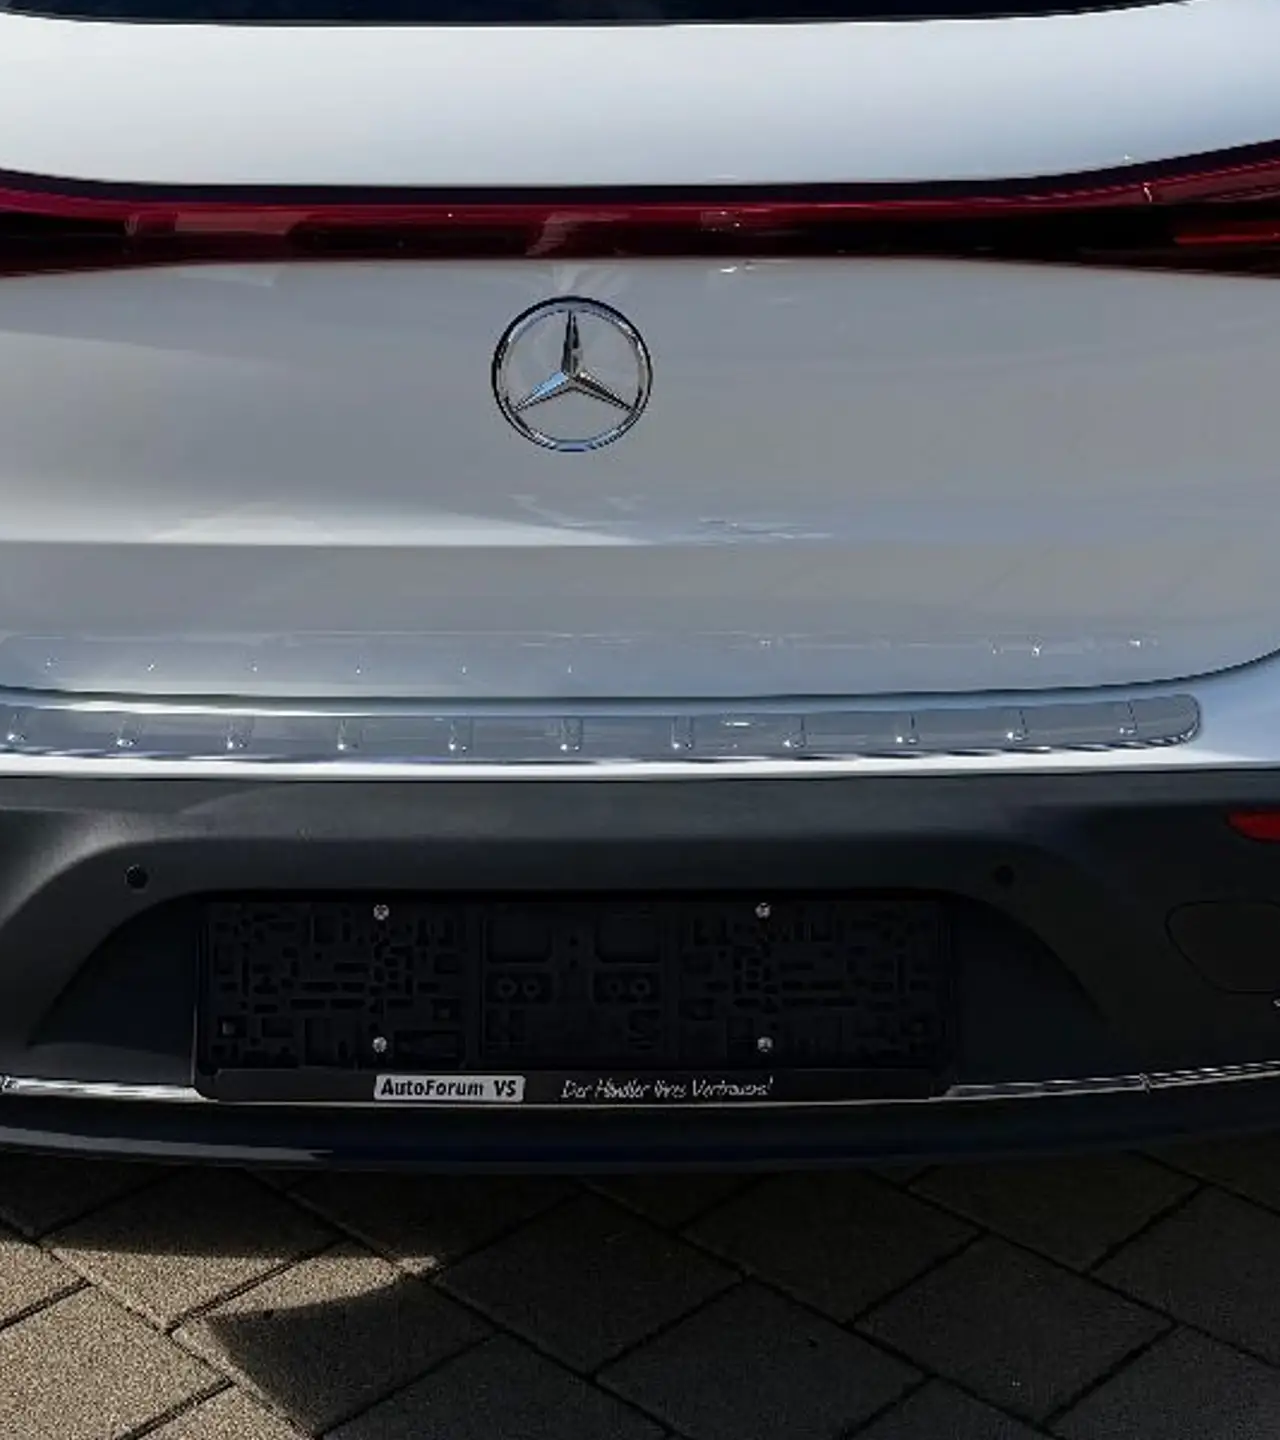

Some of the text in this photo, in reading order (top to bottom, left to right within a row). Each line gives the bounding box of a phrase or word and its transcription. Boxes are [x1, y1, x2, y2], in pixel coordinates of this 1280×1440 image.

[381, 1078, 484, 1096] AutoForum
[493, 1080, 517, 1097] VS
[562, 1080, 591, 1098] Der
